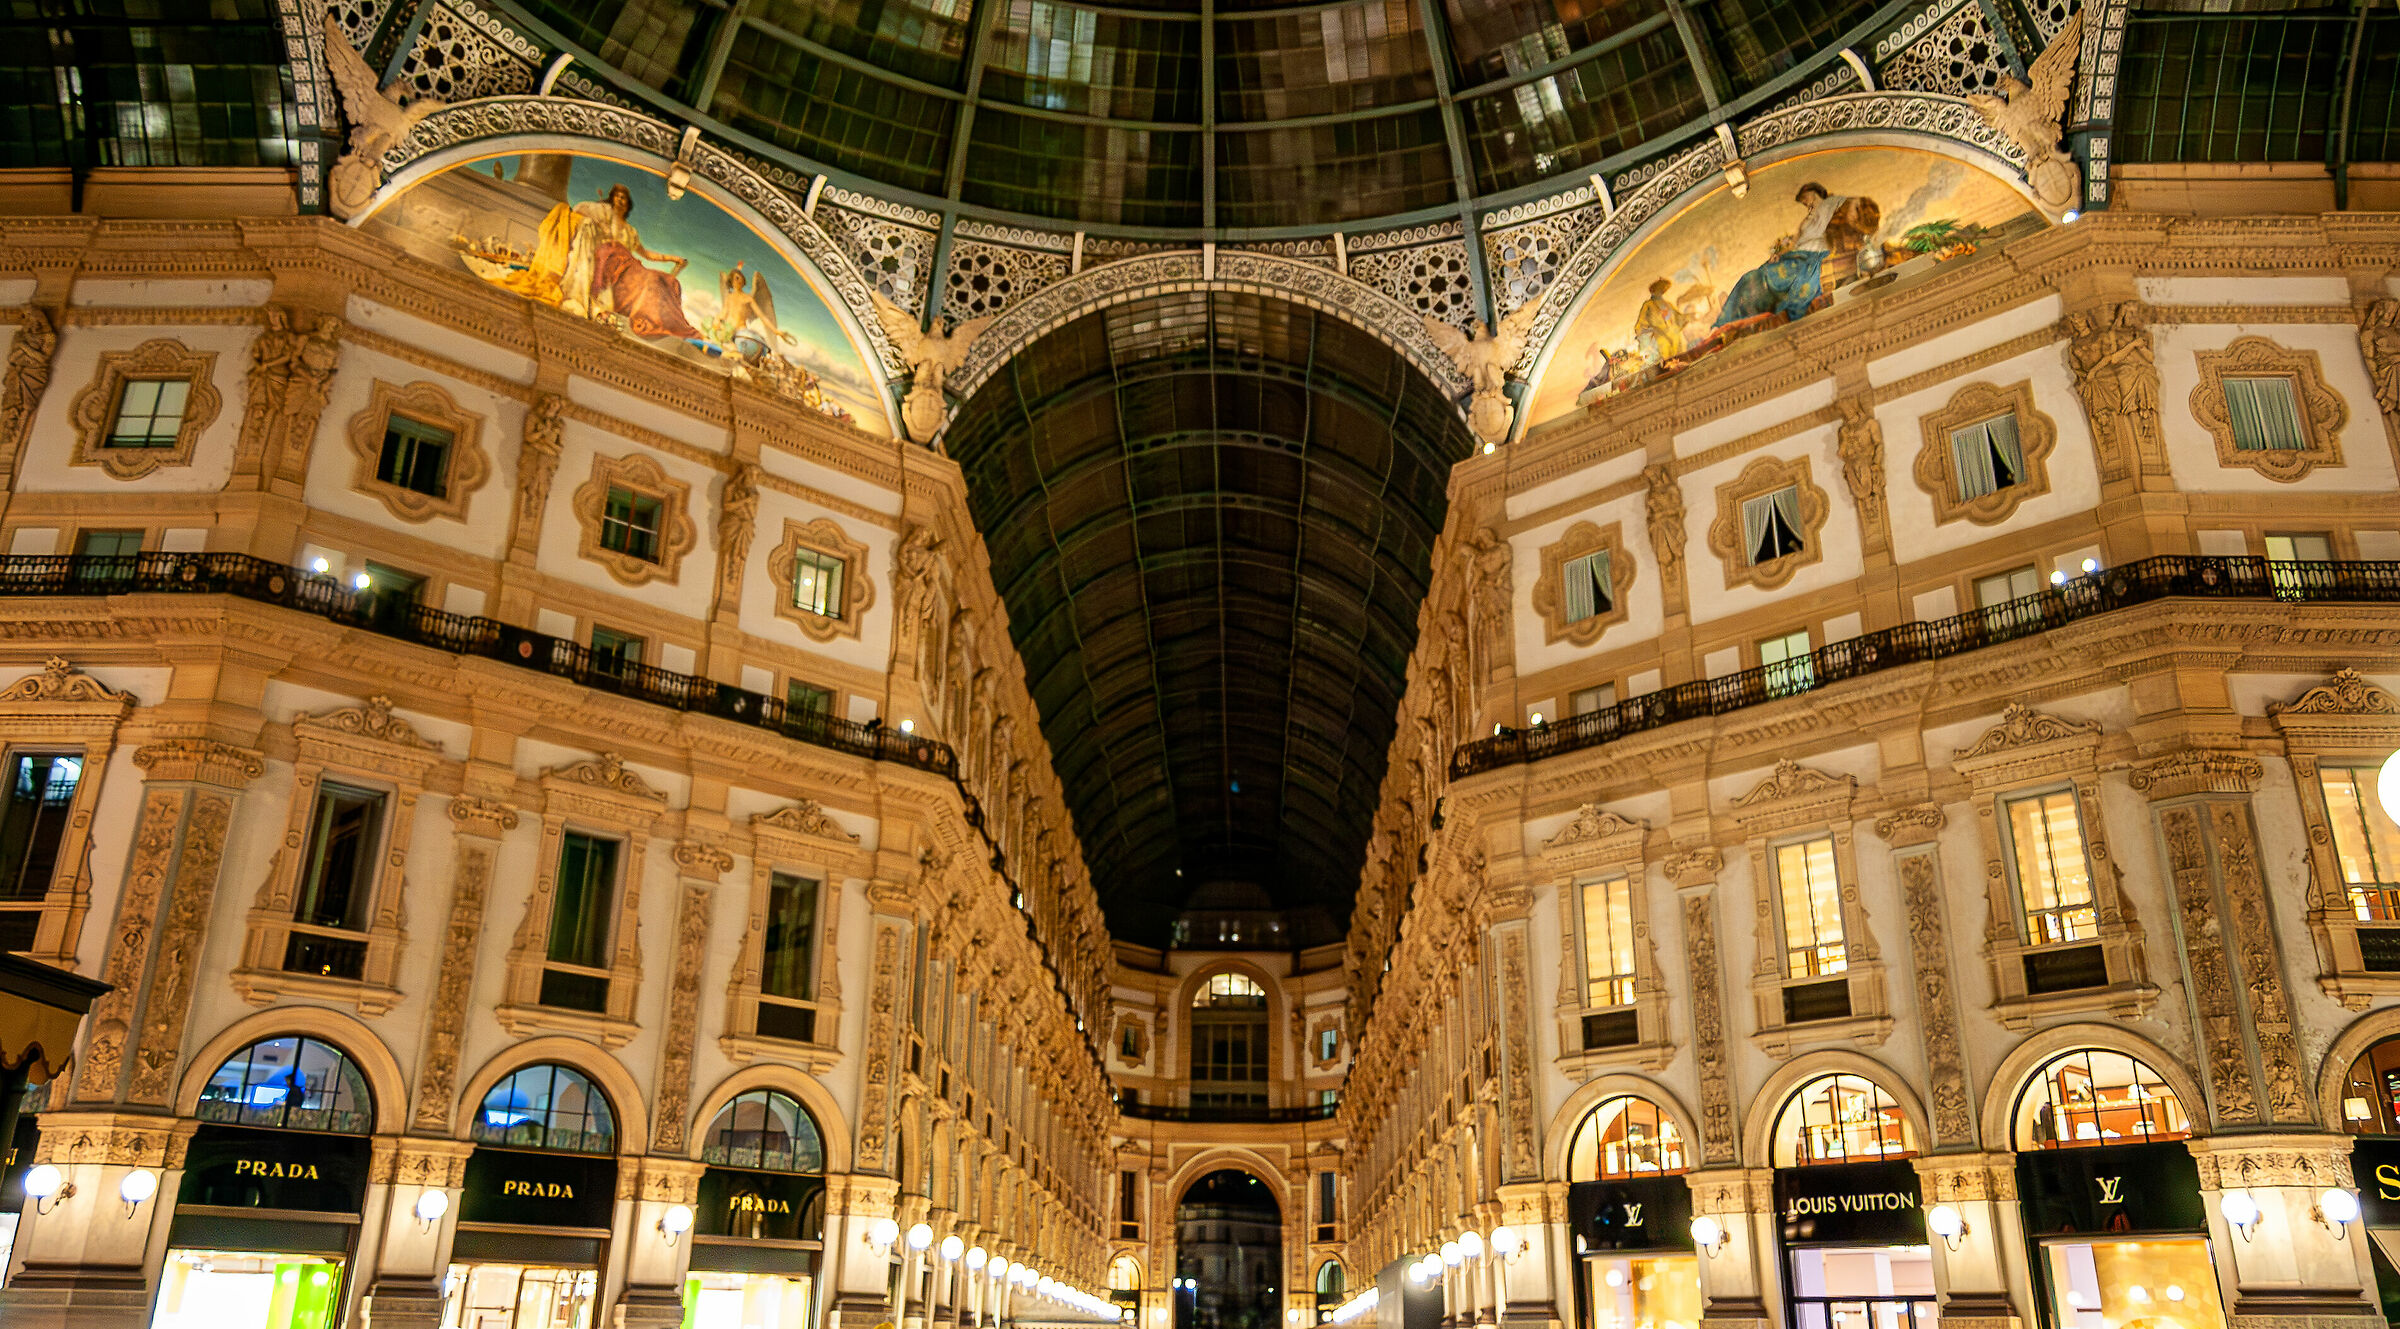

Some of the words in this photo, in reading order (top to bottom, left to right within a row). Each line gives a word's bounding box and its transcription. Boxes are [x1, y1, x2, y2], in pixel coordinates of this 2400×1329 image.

[235, 1159, 320, 1180] PRADA
[503, 1180, 574, 1199] PRADA
[729, 1196, 791, 1214] PRADA
[1788, 1196, 1837, 1215] LOUIS
[1839, 1192, 1915, 1213] VUITTON
